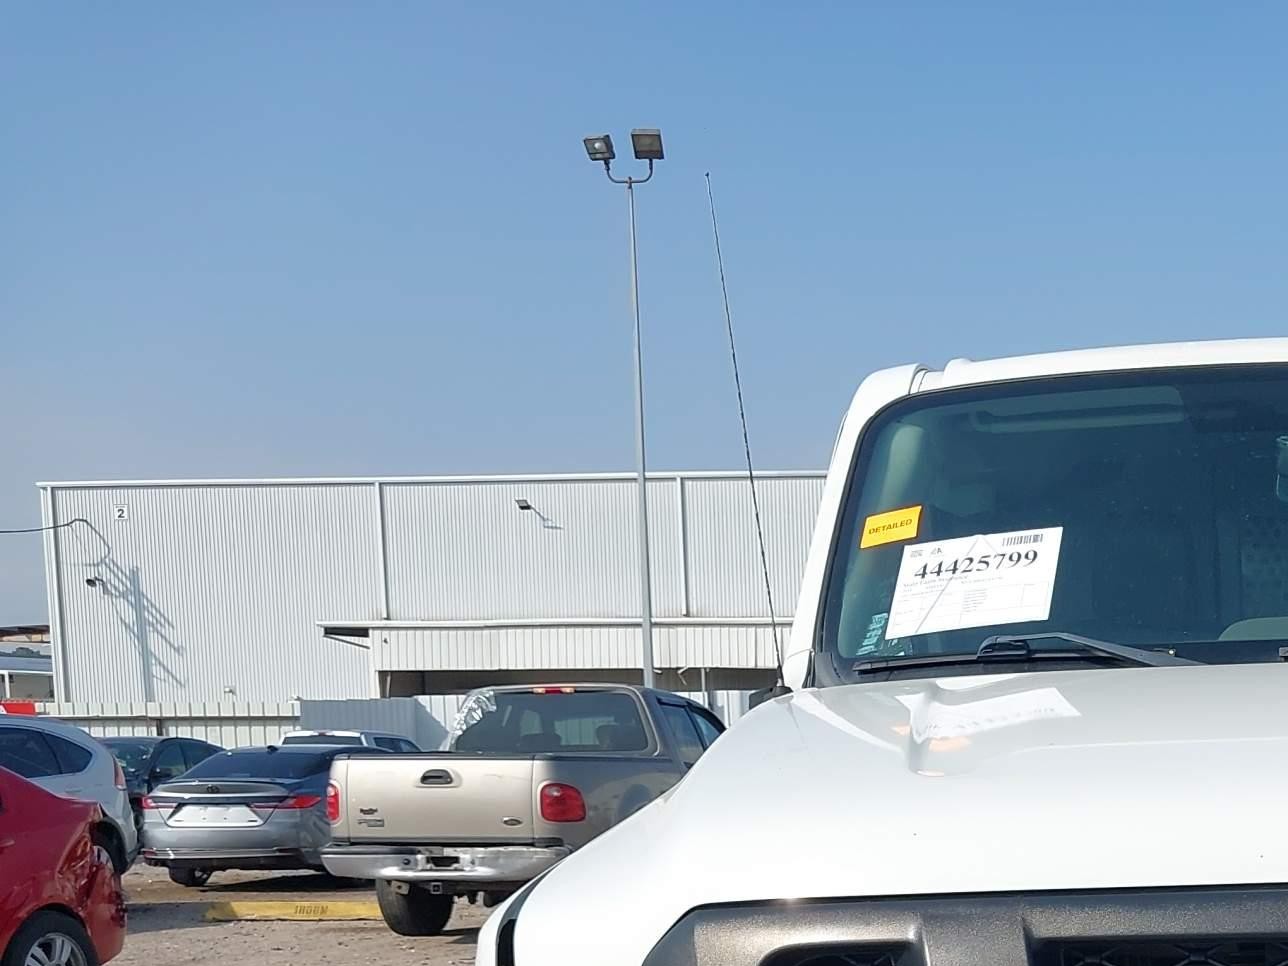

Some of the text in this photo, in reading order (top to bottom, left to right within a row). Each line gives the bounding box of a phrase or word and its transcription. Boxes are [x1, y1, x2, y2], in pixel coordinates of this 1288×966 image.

[117, 508, 125, 518] 2
[868, 518, 913, 535] DETAILED
[914, 549, 1039, 579] 44425799
